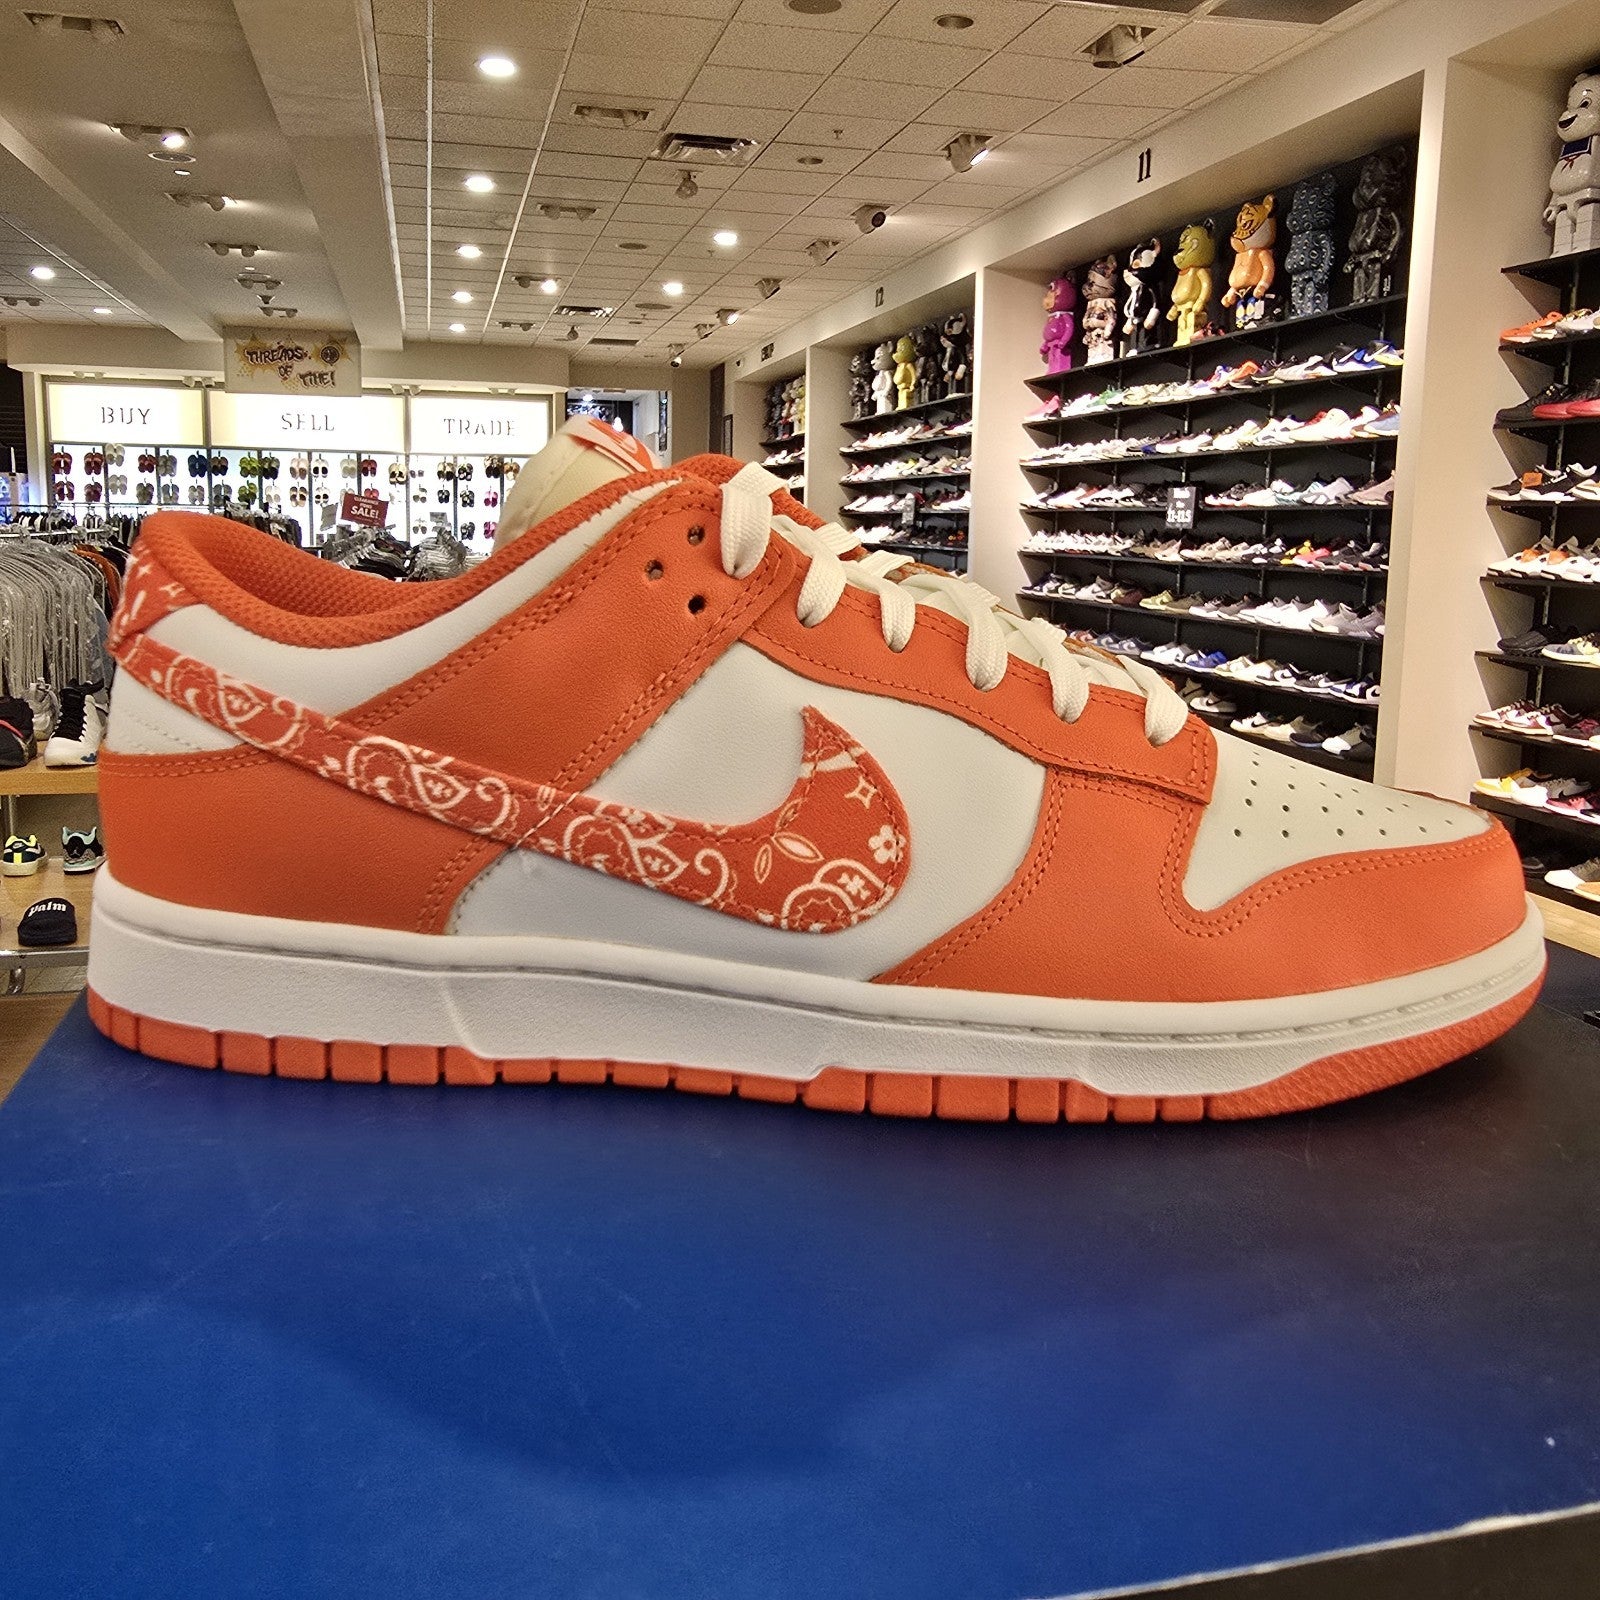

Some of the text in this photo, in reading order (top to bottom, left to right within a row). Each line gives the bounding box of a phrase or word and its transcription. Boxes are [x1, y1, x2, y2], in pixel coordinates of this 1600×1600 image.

[1137, 147, 1151, 183] 11
[246, 346, 304, 363] THREADS
[278, 364, 293, 378] OF
[101, 406, 151, 425] BUY
[281, 412, 335, 432] SELL
[443, 418, 516, 437] TRADE
[350, 505, 380, 519] SALE!
